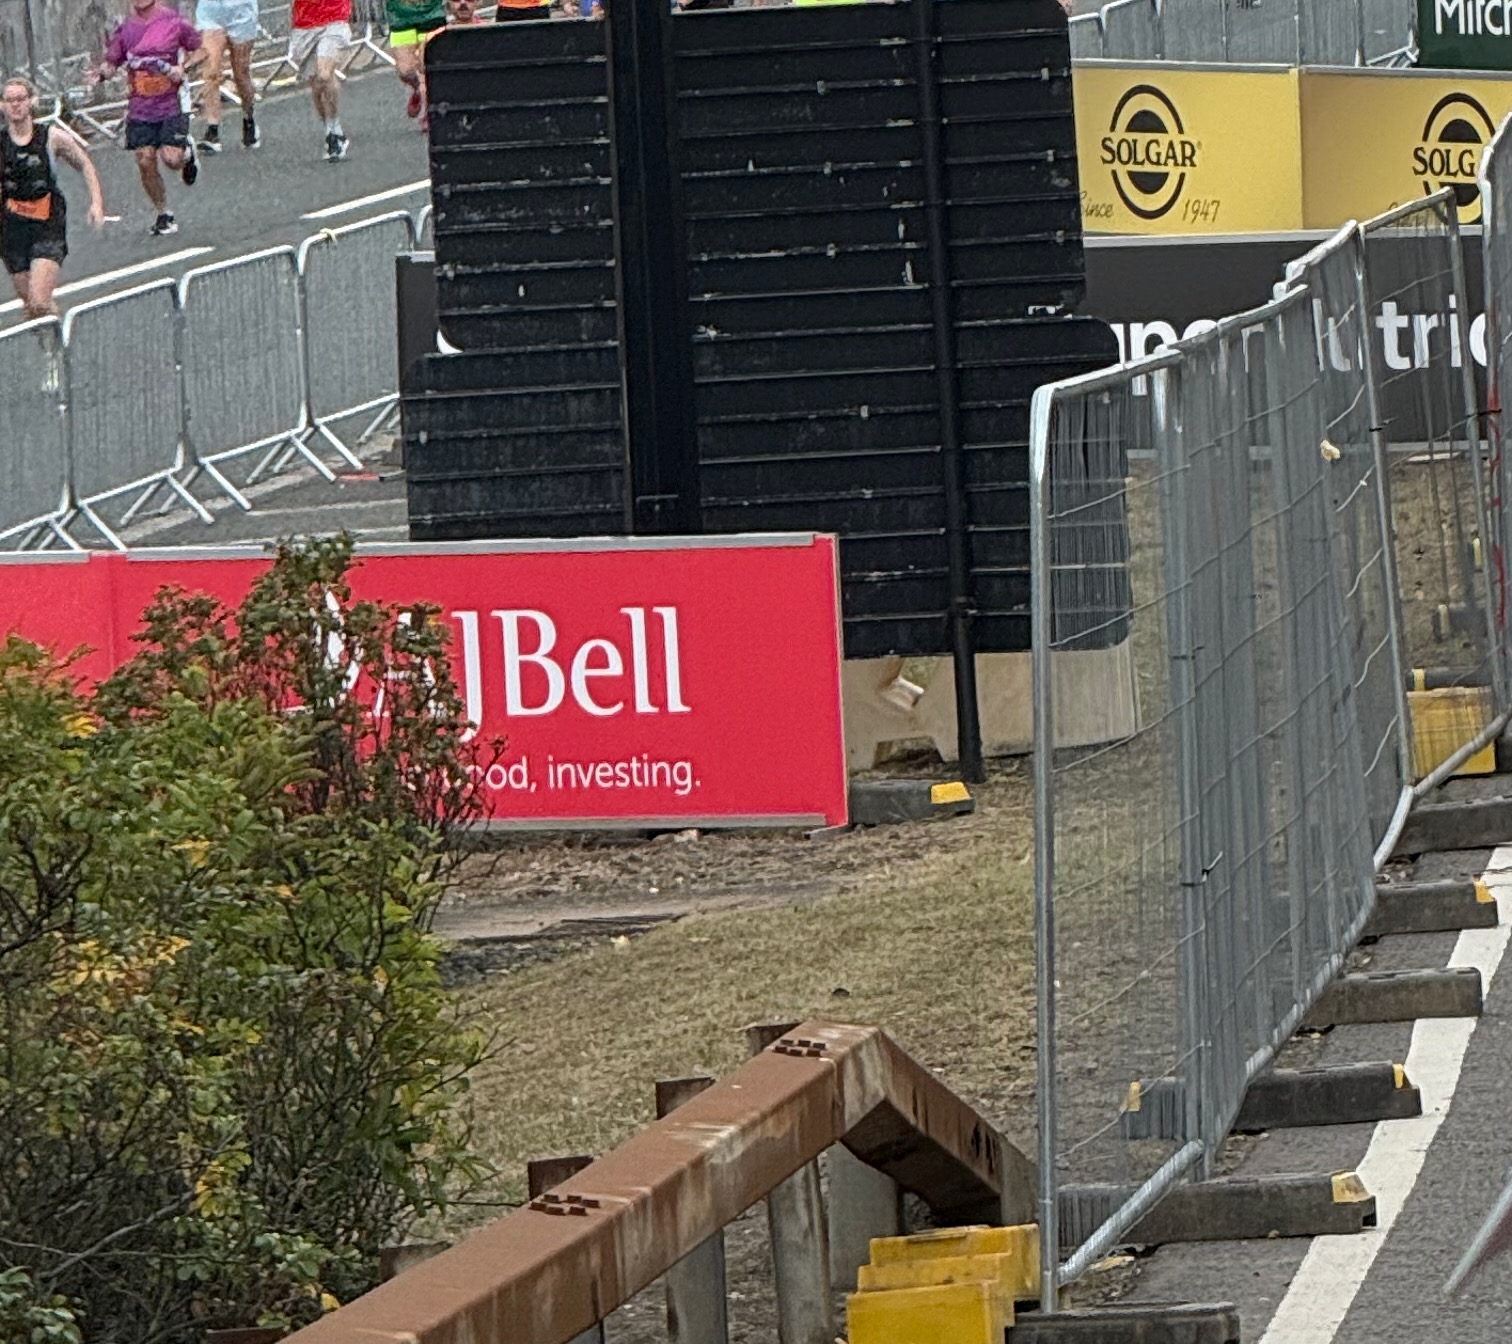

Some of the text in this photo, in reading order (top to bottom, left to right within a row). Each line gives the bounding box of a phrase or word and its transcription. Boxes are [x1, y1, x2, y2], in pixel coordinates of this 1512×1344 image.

[1100, 136, 1198, 168] SOLGAR
[1412, 145, 1477, 179] SOLG
[1181, 198, 1221, 225] 1947
[376, 605, 693, 743] JBell
[548, 753, 701, 796] investing.
